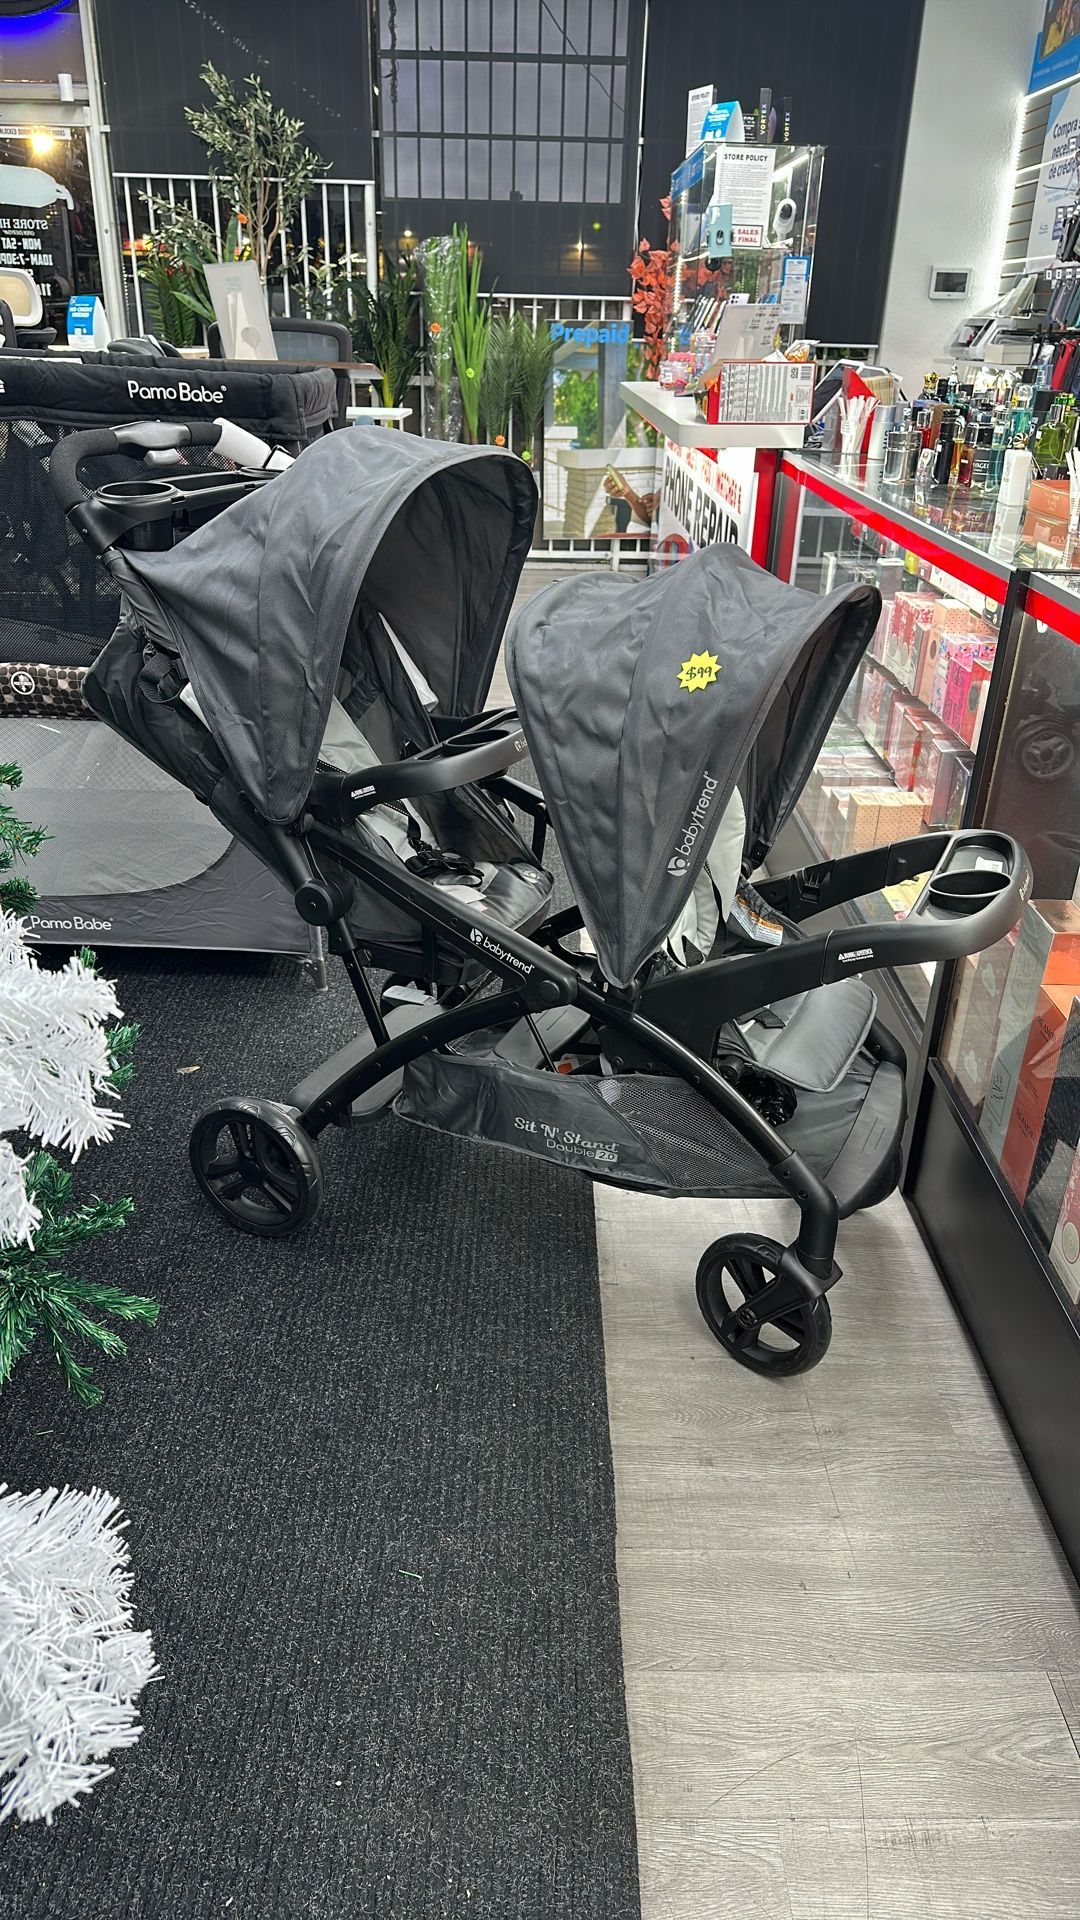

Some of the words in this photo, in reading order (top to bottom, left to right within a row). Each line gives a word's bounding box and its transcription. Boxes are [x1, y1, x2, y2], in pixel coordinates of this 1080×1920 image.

[1053, 118, 1078, 139] Compra
[724, 153, 744, 161] STORE
[745, 154, 768, 162] POLICY
[550, 322, 630, 348] Prepaid
[127, 380, 177, 400] Pamo
[663, 456, 694, 534] PHONE
[685, 666, 713, 682] $99
[675, 773, 718, 856] babytrend
[31, 915, 73, 930] Pamo
[483, 936, 532, 975] babytrend
[514, 1116, 538, 1134] Sit
[563, 1130, 618, 1153] Stand
[546, 1138, 595, 1159] Double
[597, 1151, 616, 1161] 2.0
